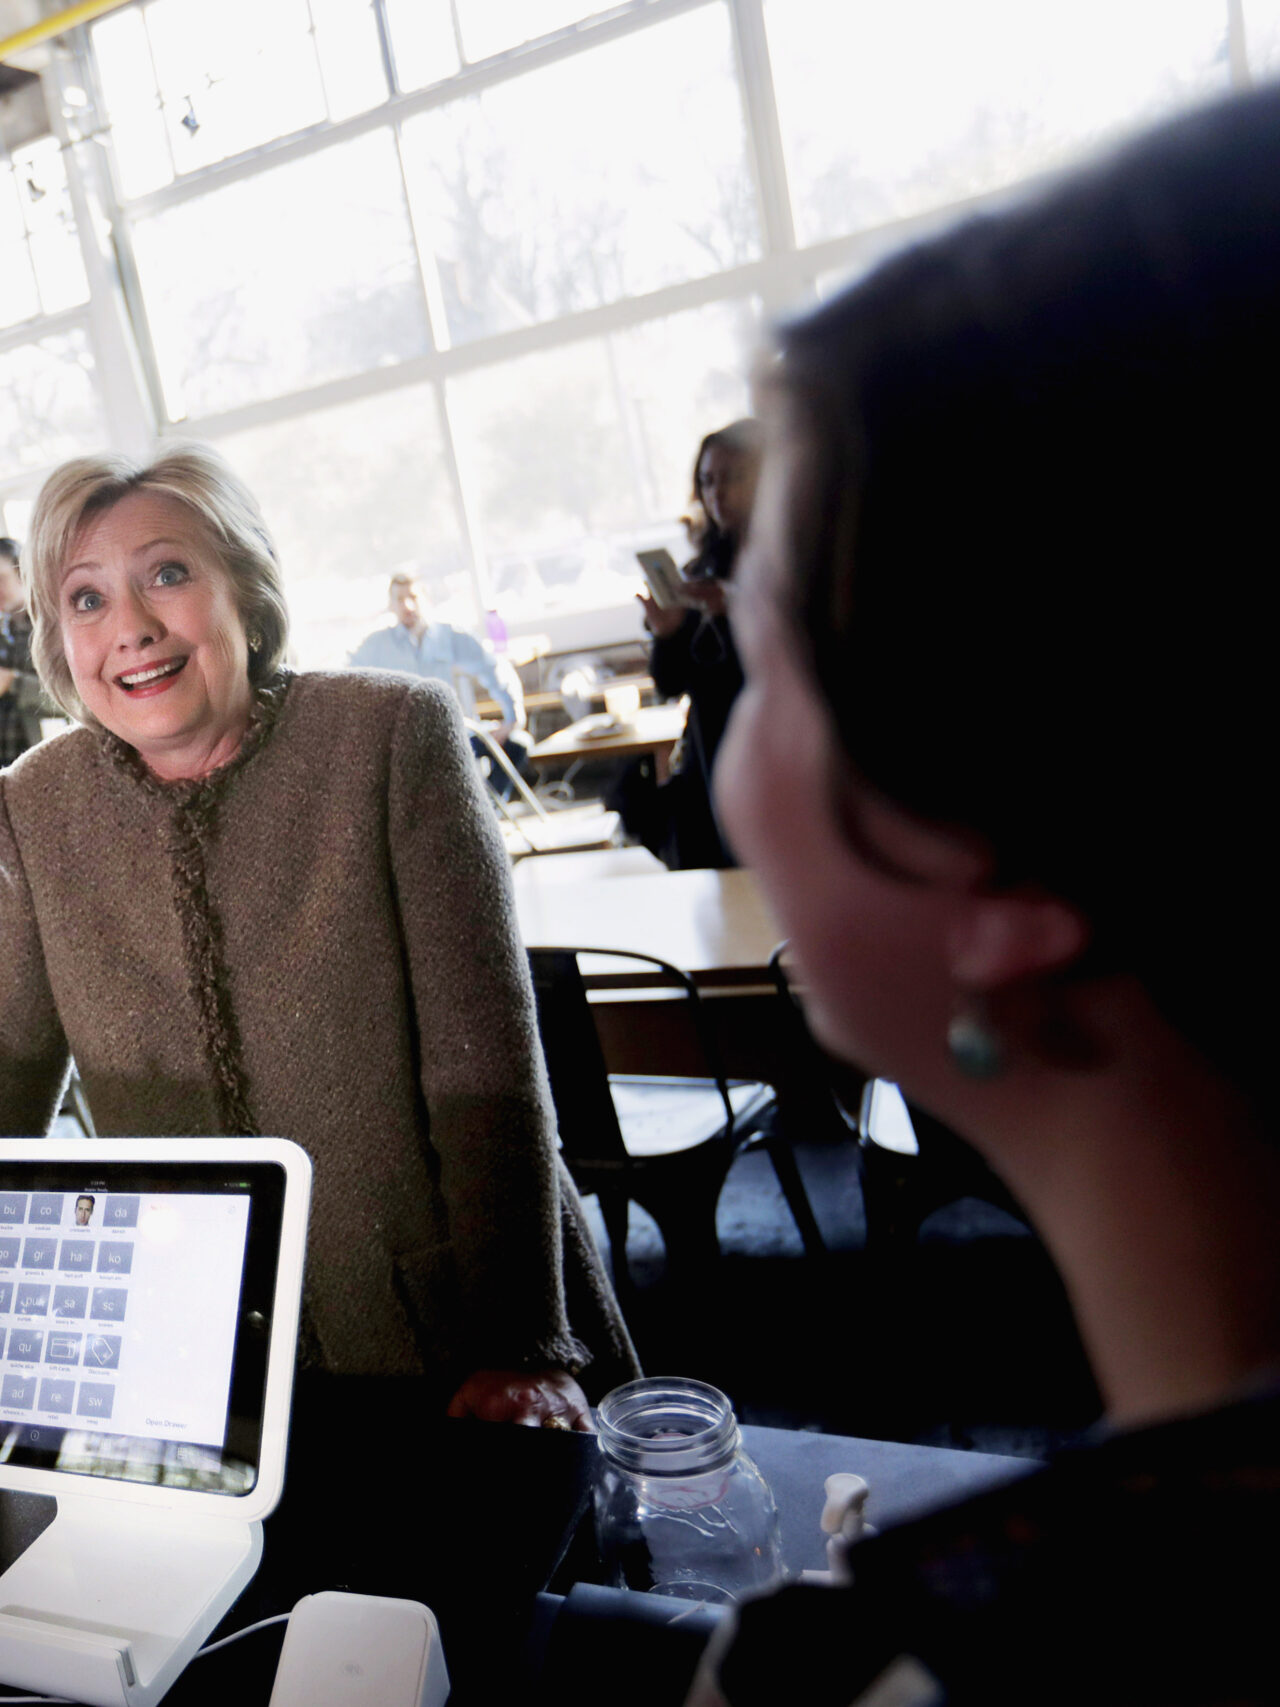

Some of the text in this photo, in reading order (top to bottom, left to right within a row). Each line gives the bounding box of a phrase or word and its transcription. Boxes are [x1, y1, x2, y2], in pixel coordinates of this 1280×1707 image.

[3, 1204, 16, 1215] bu
[40, 1205, 52, 1216] co
[114, 1207, 127, 1218] da
[108, 1253, 121, 1265] ko
[64, 1298, 76, 1309] sa
[102, 1301, 114, 1311] sc
[18, 1342, 32, 1354] qu
[11, 1388, 25, 1400] ad
[50, 1392, 63, 1402] re
[88, 1397, 103, 1407] sw
[145, 1417, 163, 1427] Open
